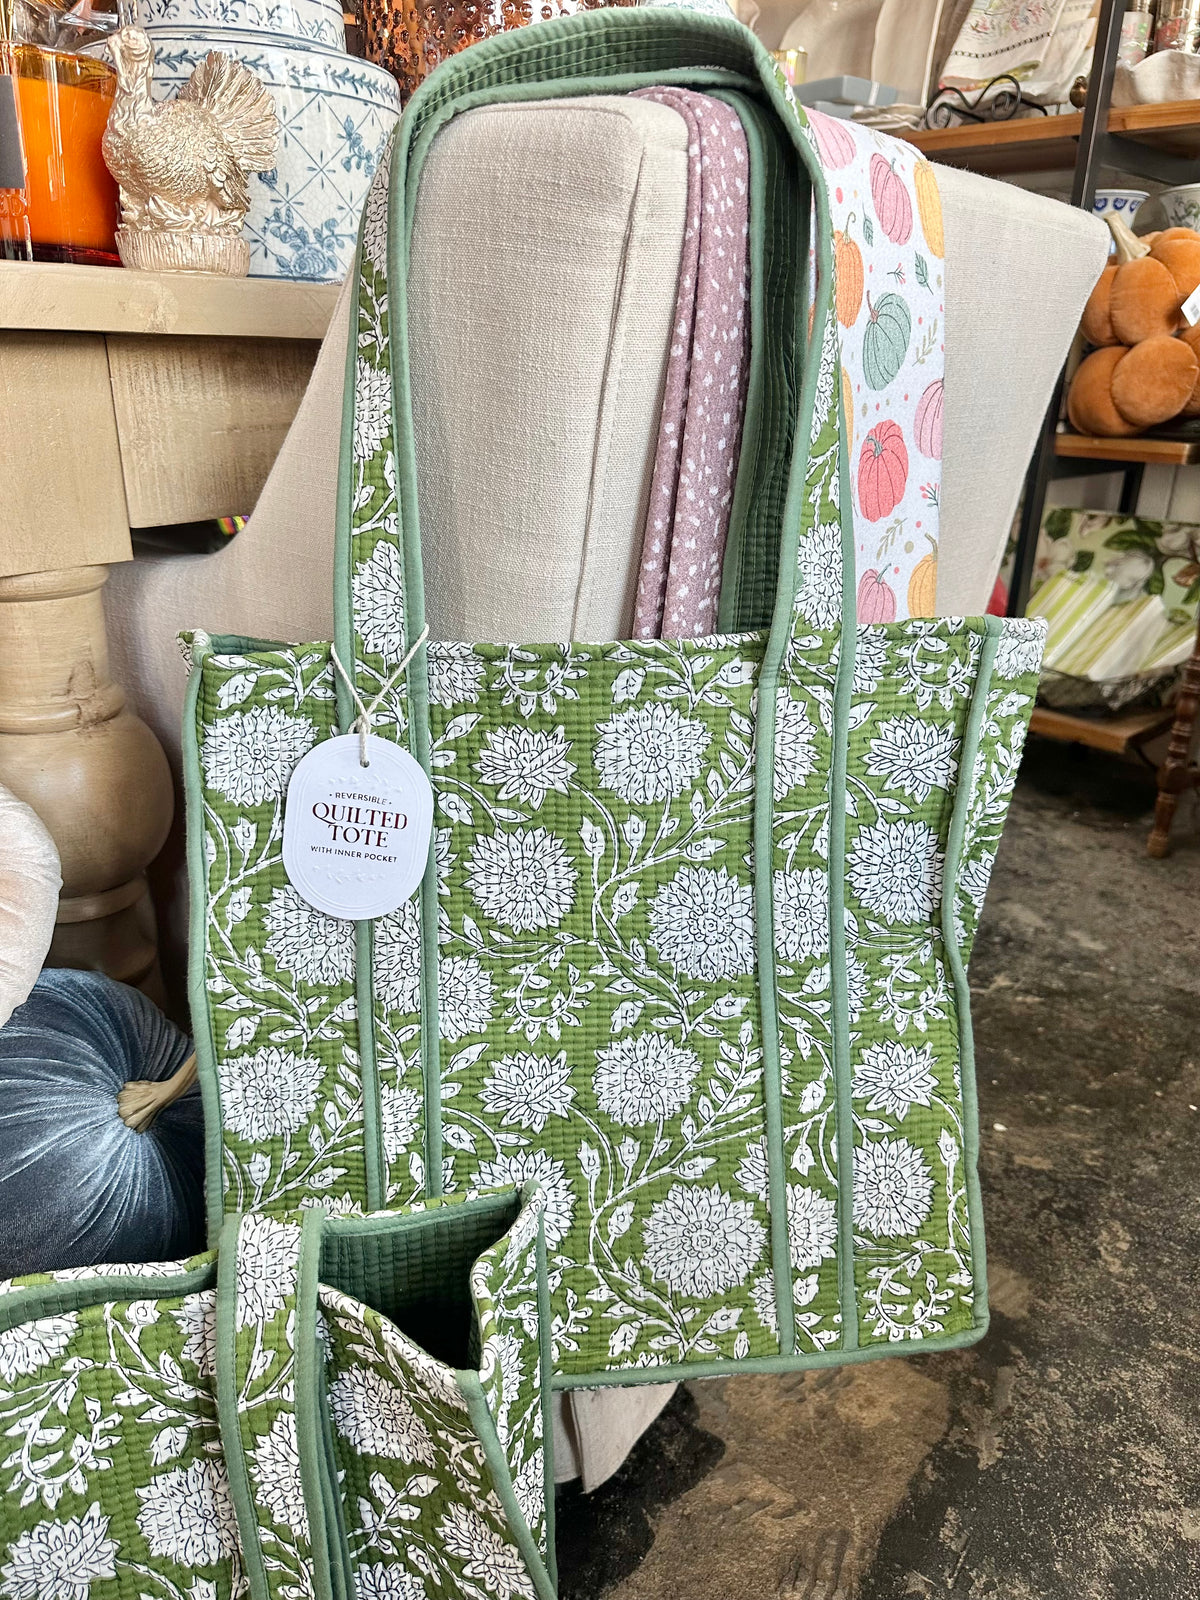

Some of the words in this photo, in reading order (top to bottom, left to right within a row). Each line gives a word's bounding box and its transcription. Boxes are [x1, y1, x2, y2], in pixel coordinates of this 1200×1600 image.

[335, 792, 388, 805] REVERSIBLE
[312, 802, 408, 830] QUILTED
[327, 824, 389, 848] TOTE
[310, 845, 333, 855] WITH
[334, 848, 362, 858] INNER
[364, 853, 398, 863] POCKET
